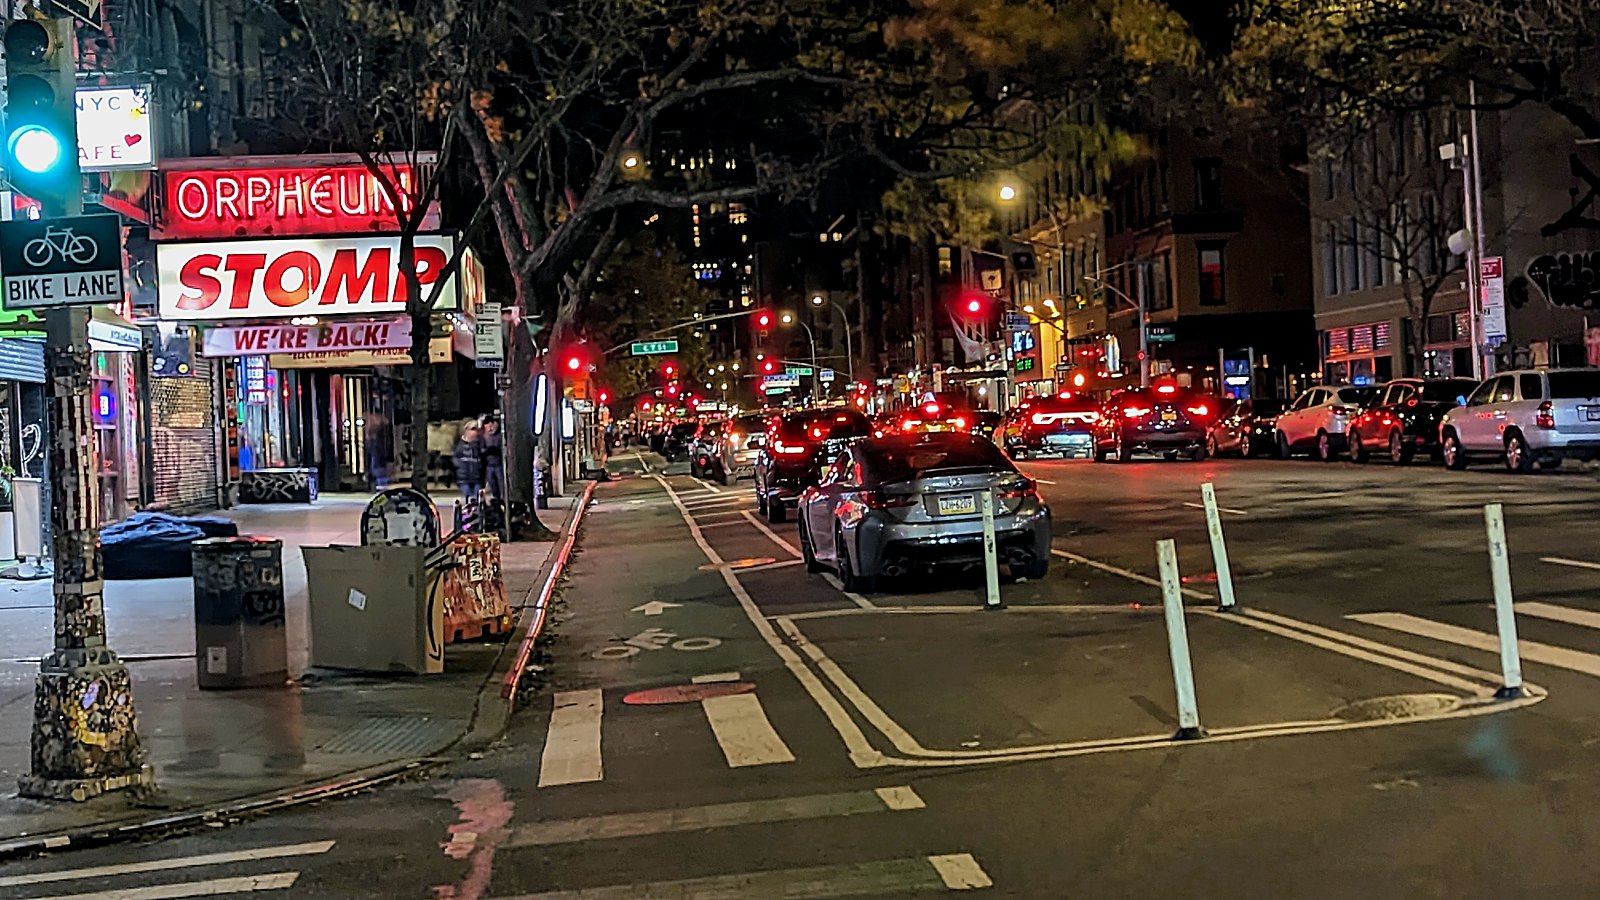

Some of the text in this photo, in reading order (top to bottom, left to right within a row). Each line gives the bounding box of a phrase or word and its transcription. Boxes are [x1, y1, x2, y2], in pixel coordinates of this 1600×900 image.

[75, 97, 120, 111] NYC
[79, 145, 122, 160] AFE
[177, 172, 409, 219] ORPHEUM
[9, 274, 117, 301] BIKE LANE
[175, 246, 448, 311] STOMP
[233, 324, 389, 351] WE'RE BACK!
